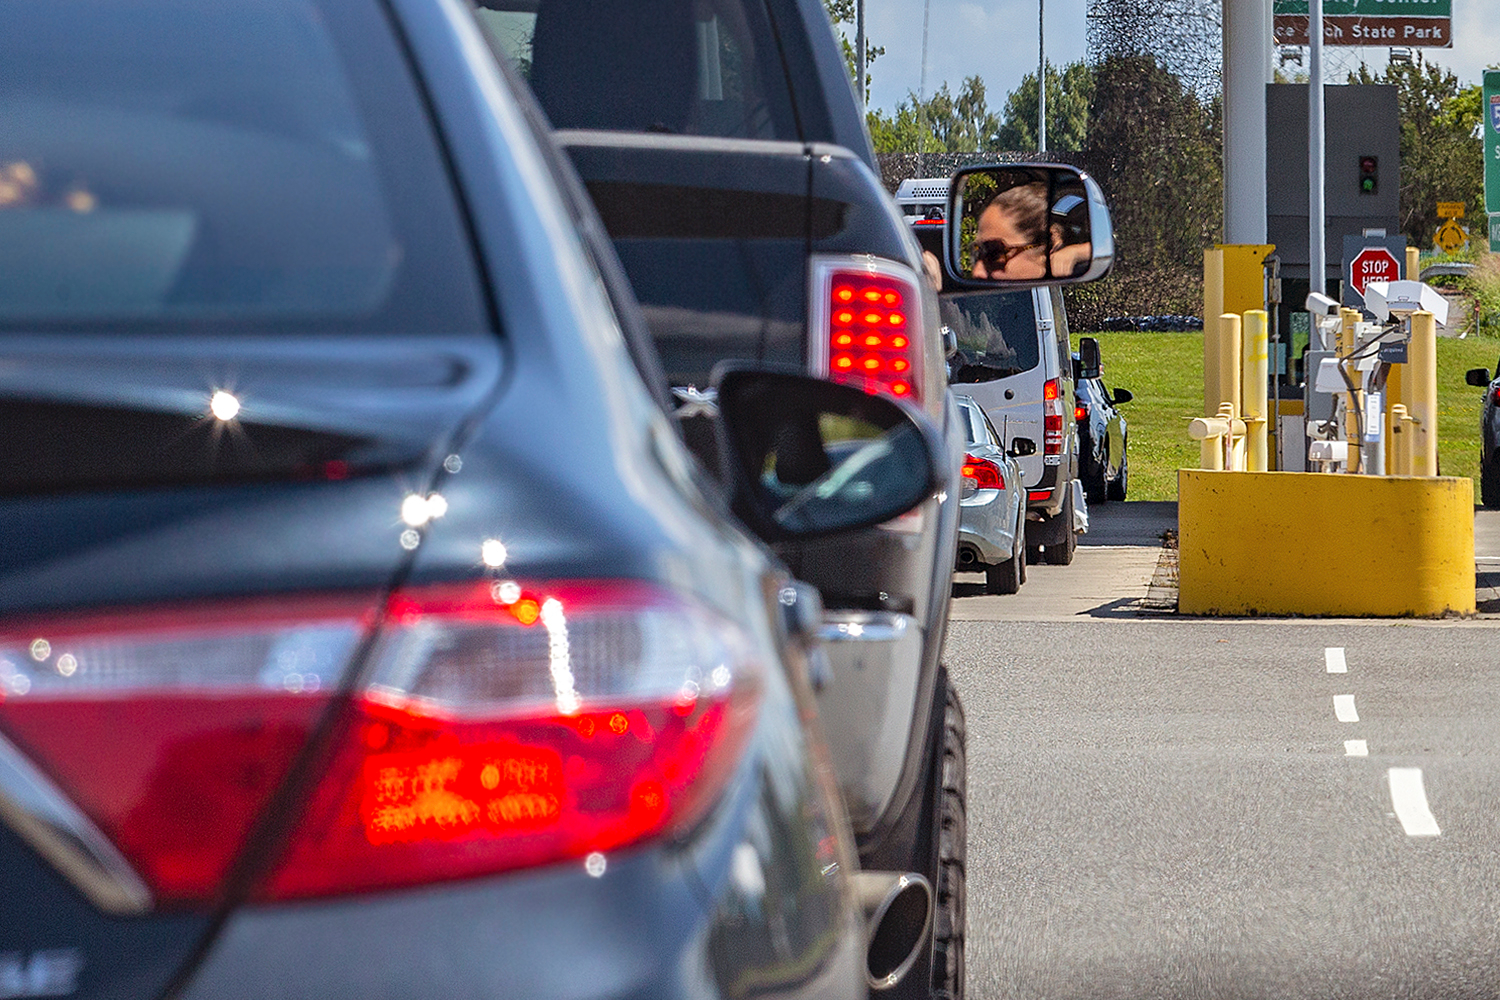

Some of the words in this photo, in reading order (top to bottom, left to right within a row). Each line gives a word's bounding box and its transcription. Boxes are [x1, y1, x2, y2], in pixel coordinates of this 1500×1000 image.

[1352, 25, 1396, 39] State
[1403, 25, 1442, 39] Park
[1362, 260, 1389, 274] STOP
